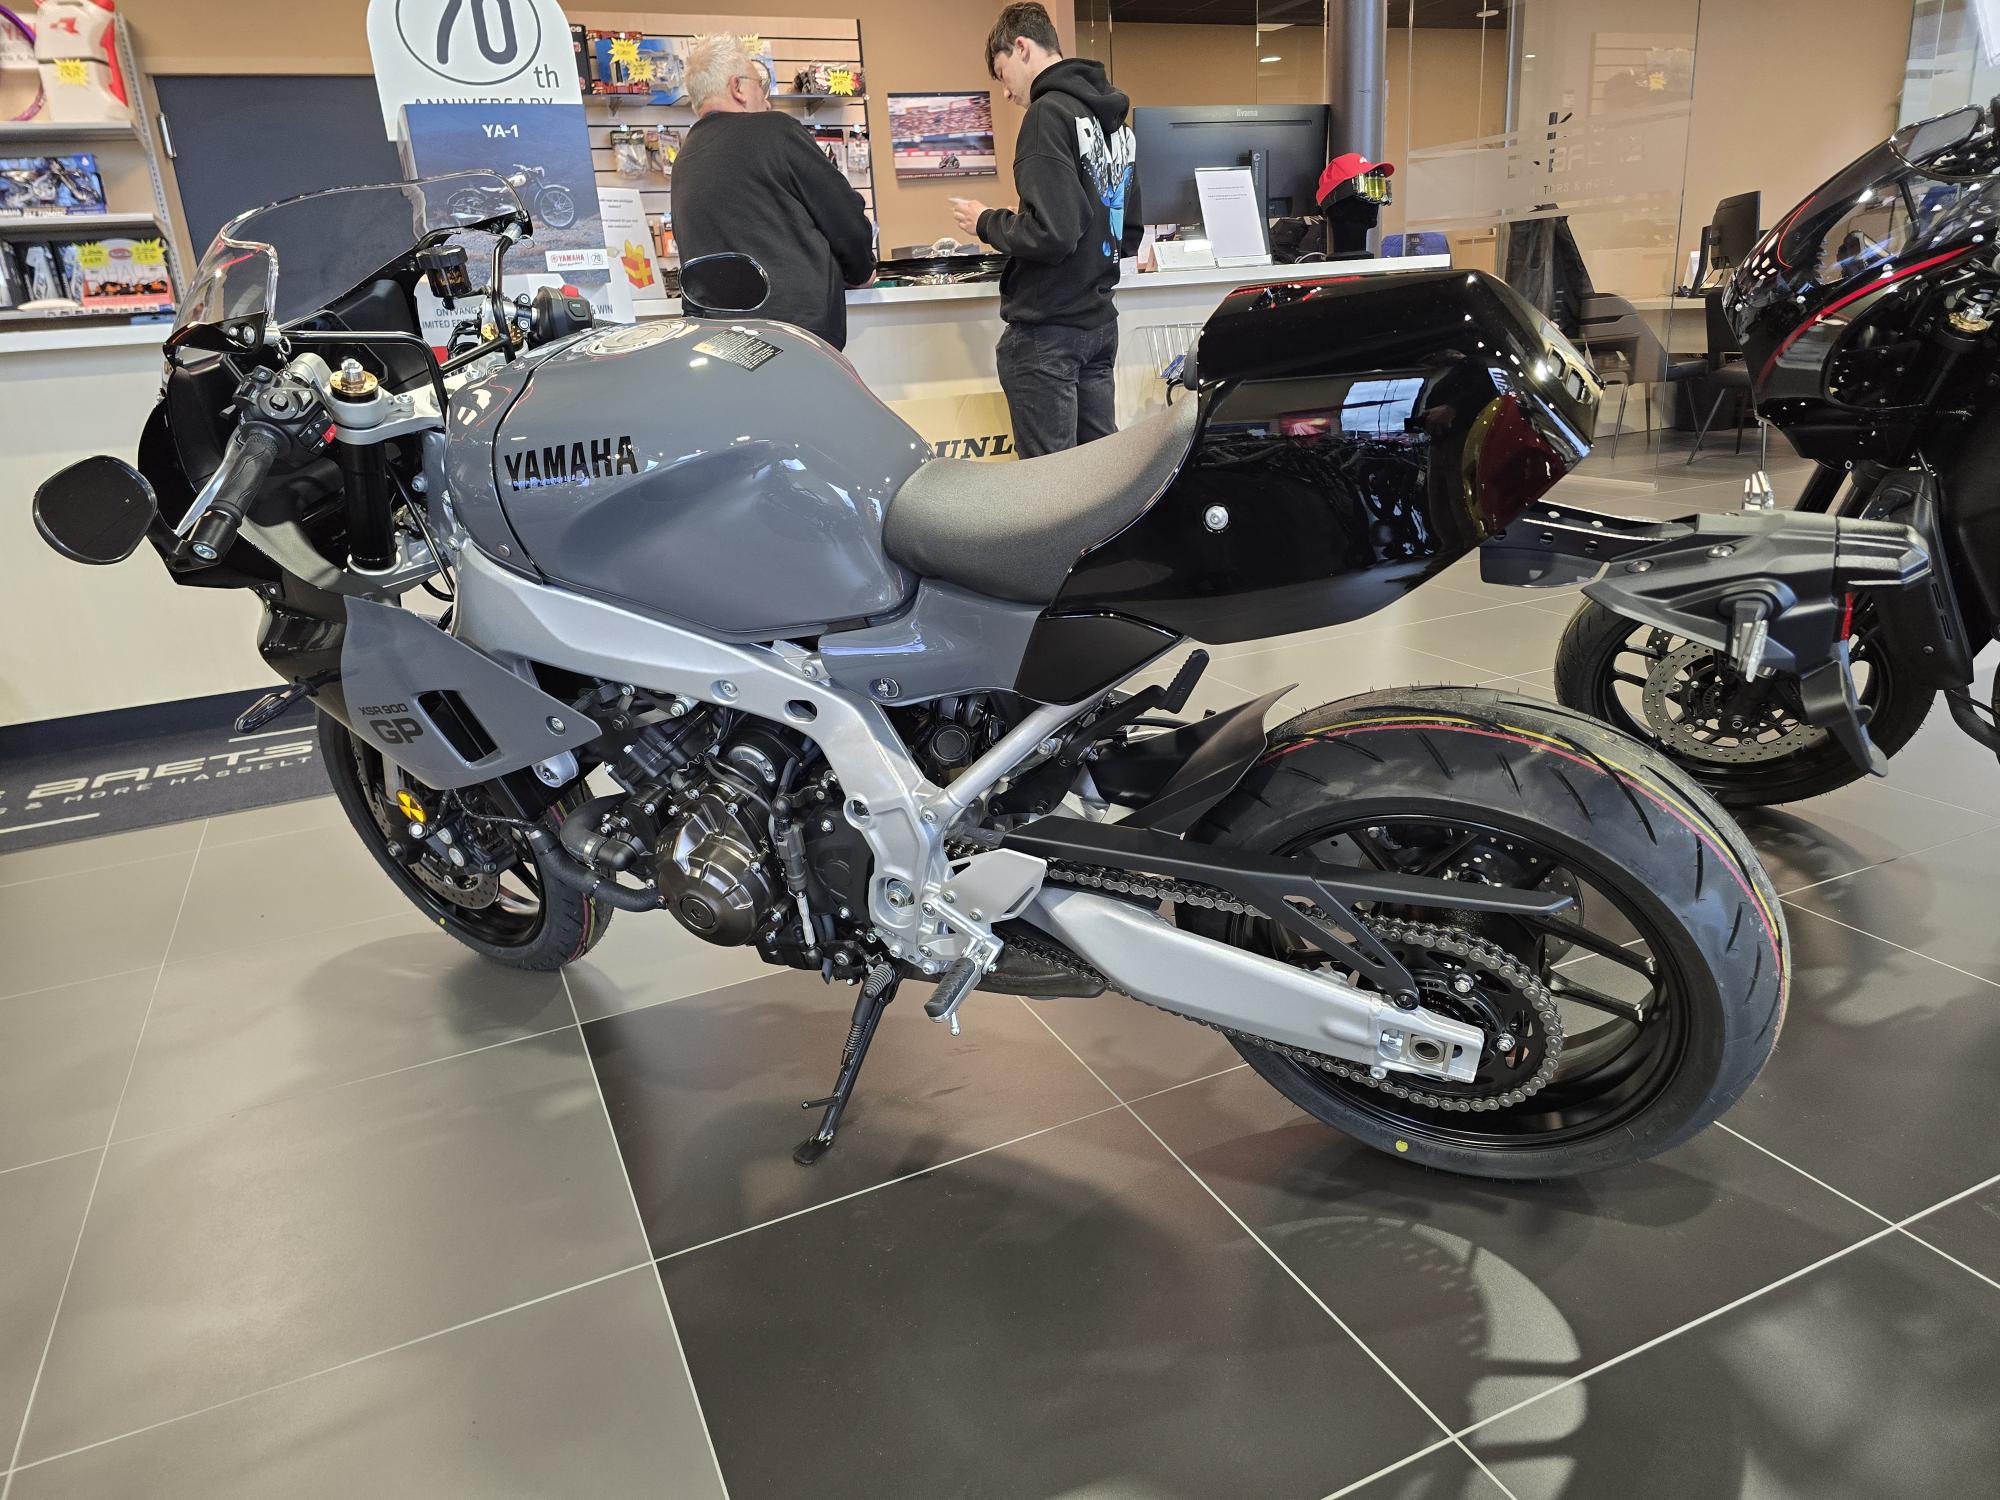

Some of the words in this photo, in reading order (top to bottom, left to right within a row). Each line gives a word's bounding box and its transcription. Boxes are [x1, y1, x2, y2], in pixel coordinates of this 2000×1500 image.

[533, 63, 560, 88] th
[482, 124, 519, 138] YA-1
[558, 254, 585, 262] YAMAHA
[596, 303, 613, 314] WIN
[422, 319, 450, 329] IMITED
[504, 435, 639, 491] YAMAHA
[369, 717, 424, 744] GP
[27, 740, 313, 800] BAETS
[63, 782, 153, 805] MORE
[170, 756, 313, 786] HASSELT
